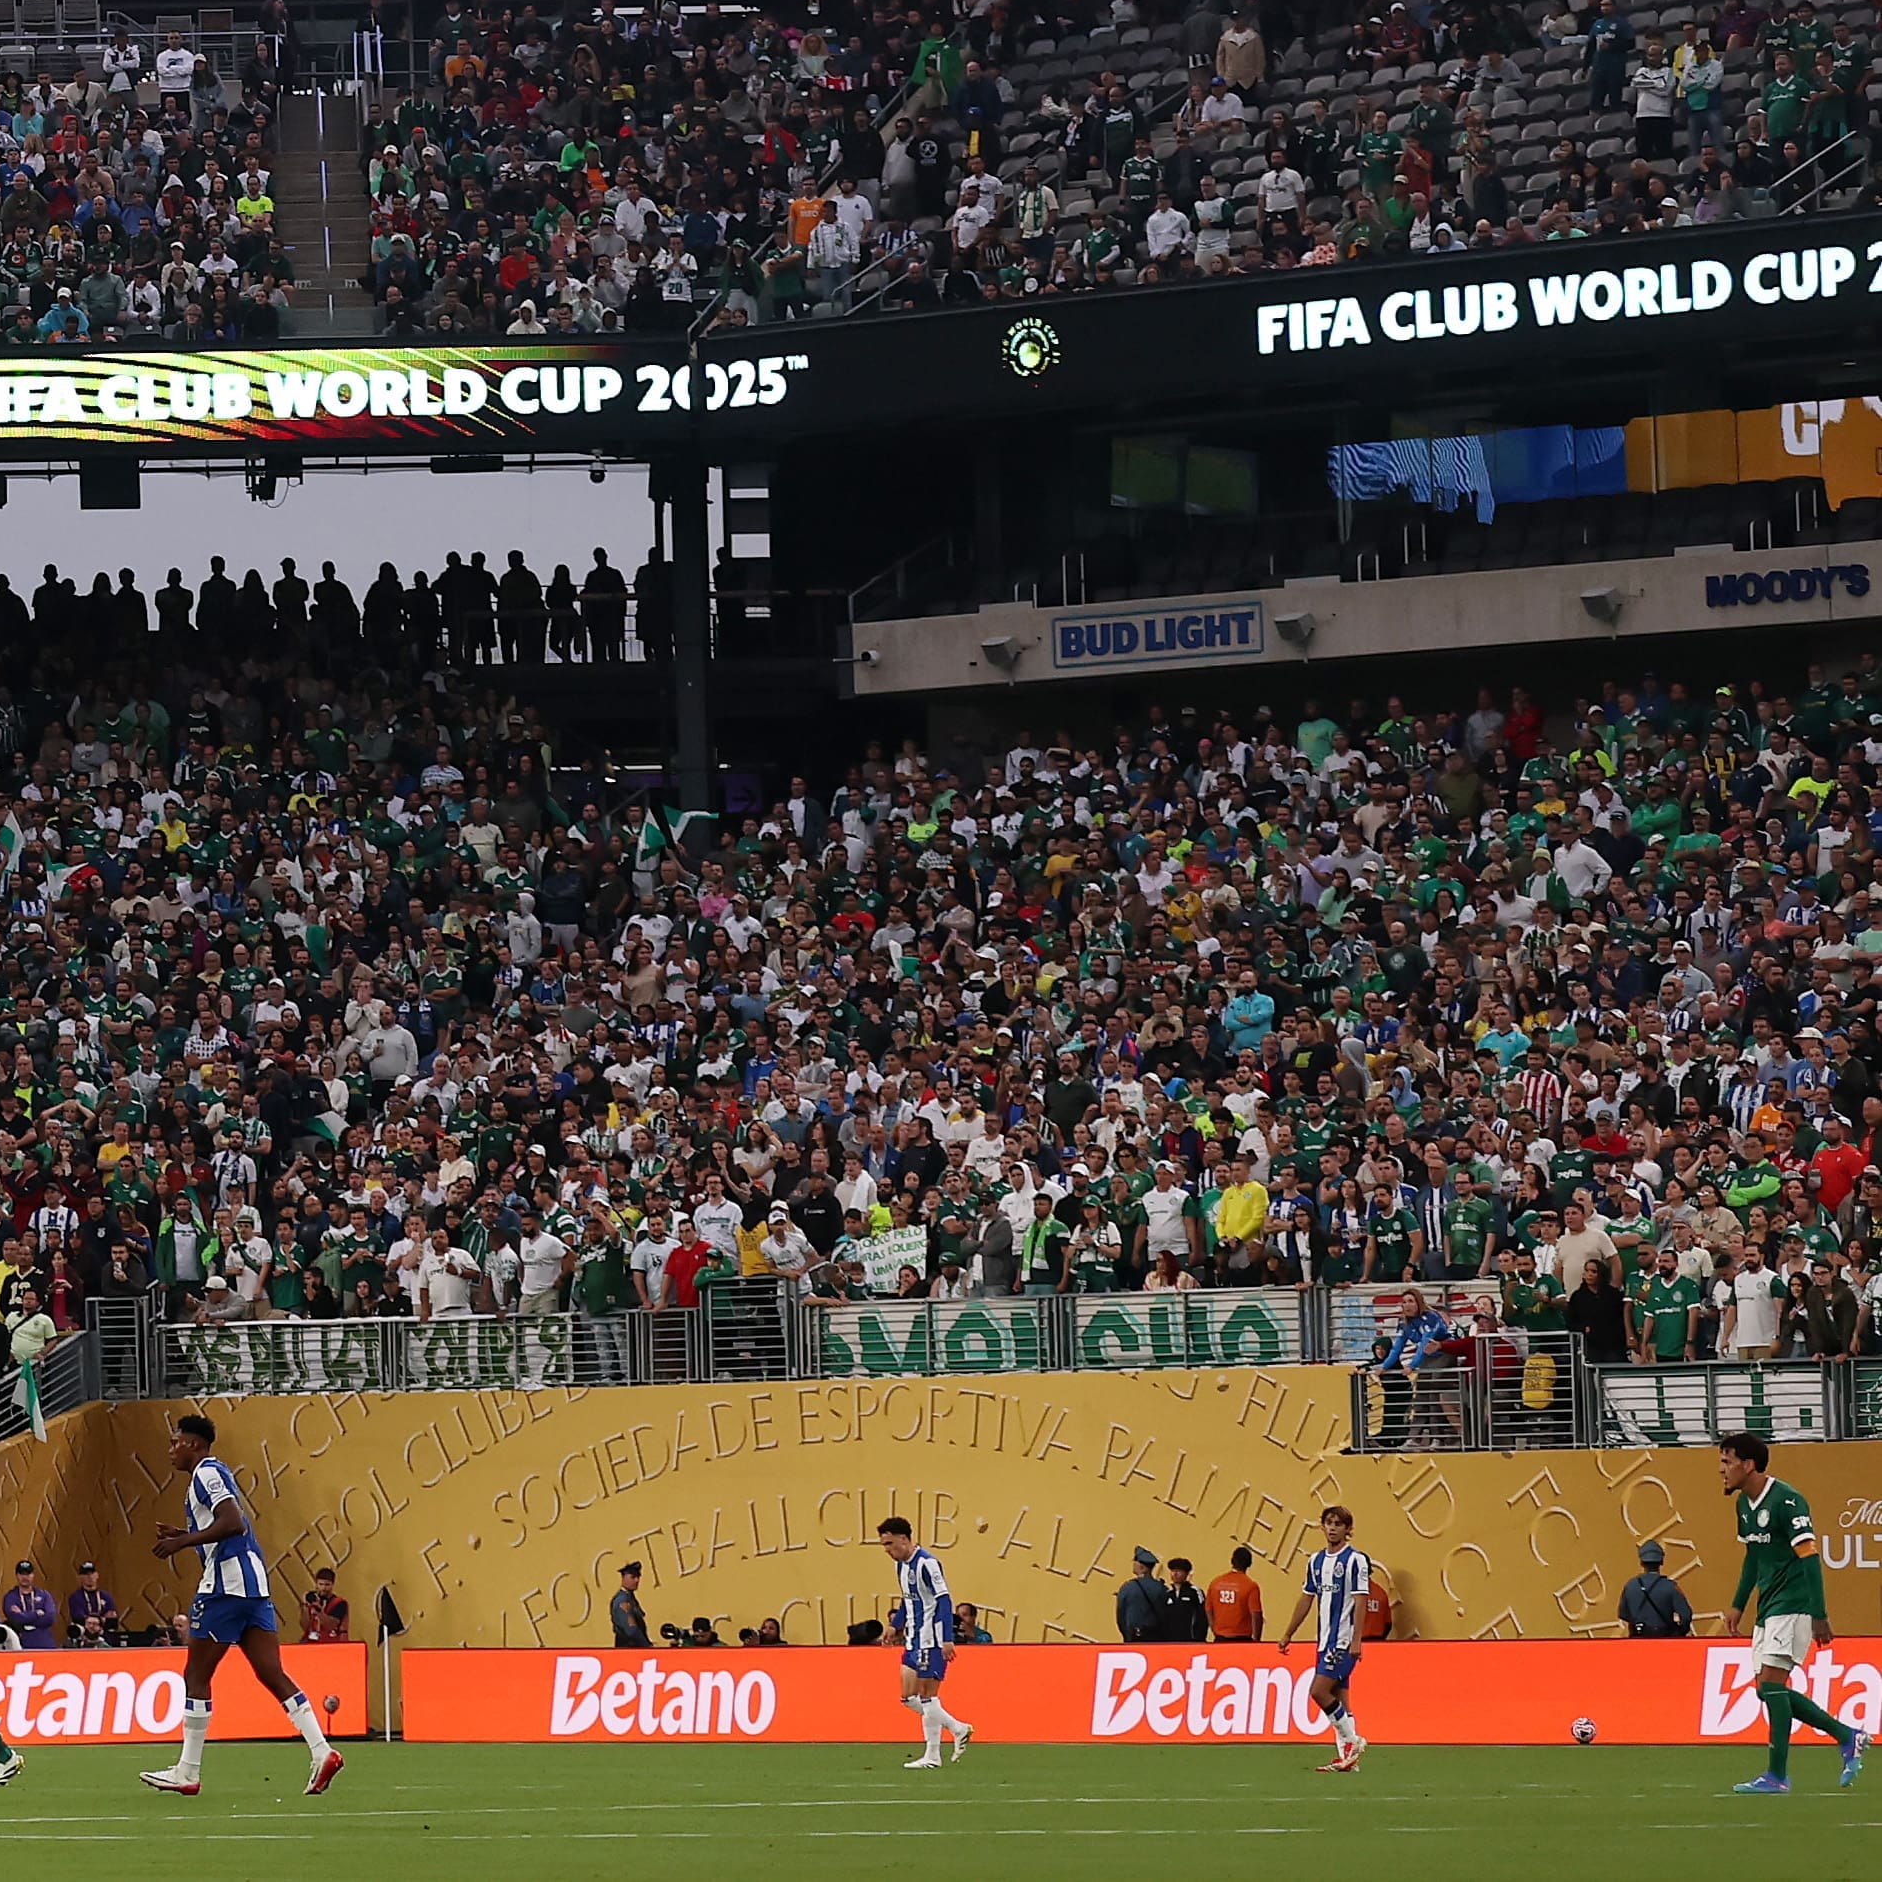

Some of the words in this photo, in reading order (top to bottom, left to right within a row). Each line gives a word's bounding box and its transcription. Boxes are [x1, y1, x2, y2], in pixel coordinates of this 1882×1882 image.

[1256, 296, 1372, 355] FIFA
[1379, 281, 1519, 342] CLUB
[1529, 260, 1733, 327] WORLD
[1742, 246, 1857, 304] CUP
[97, 372, 253, 422] CLUB
[265, 364, 489, 418] WORLD
[499, 363, 624, 415] CUP
[1706, 564, 1871, 607] MOODY'S
[1060, 619, 1140, 659] BUD
[1143, 611, 1254, 655] LIGHT
[492, 1392, 779, 1548] SOCIEDADE
[796, 1383, 1078, 1469] ESPORTIVA
[548, 1655, 777, 1736] Betano
[1090, 1651, 1328, 1736] Betano
